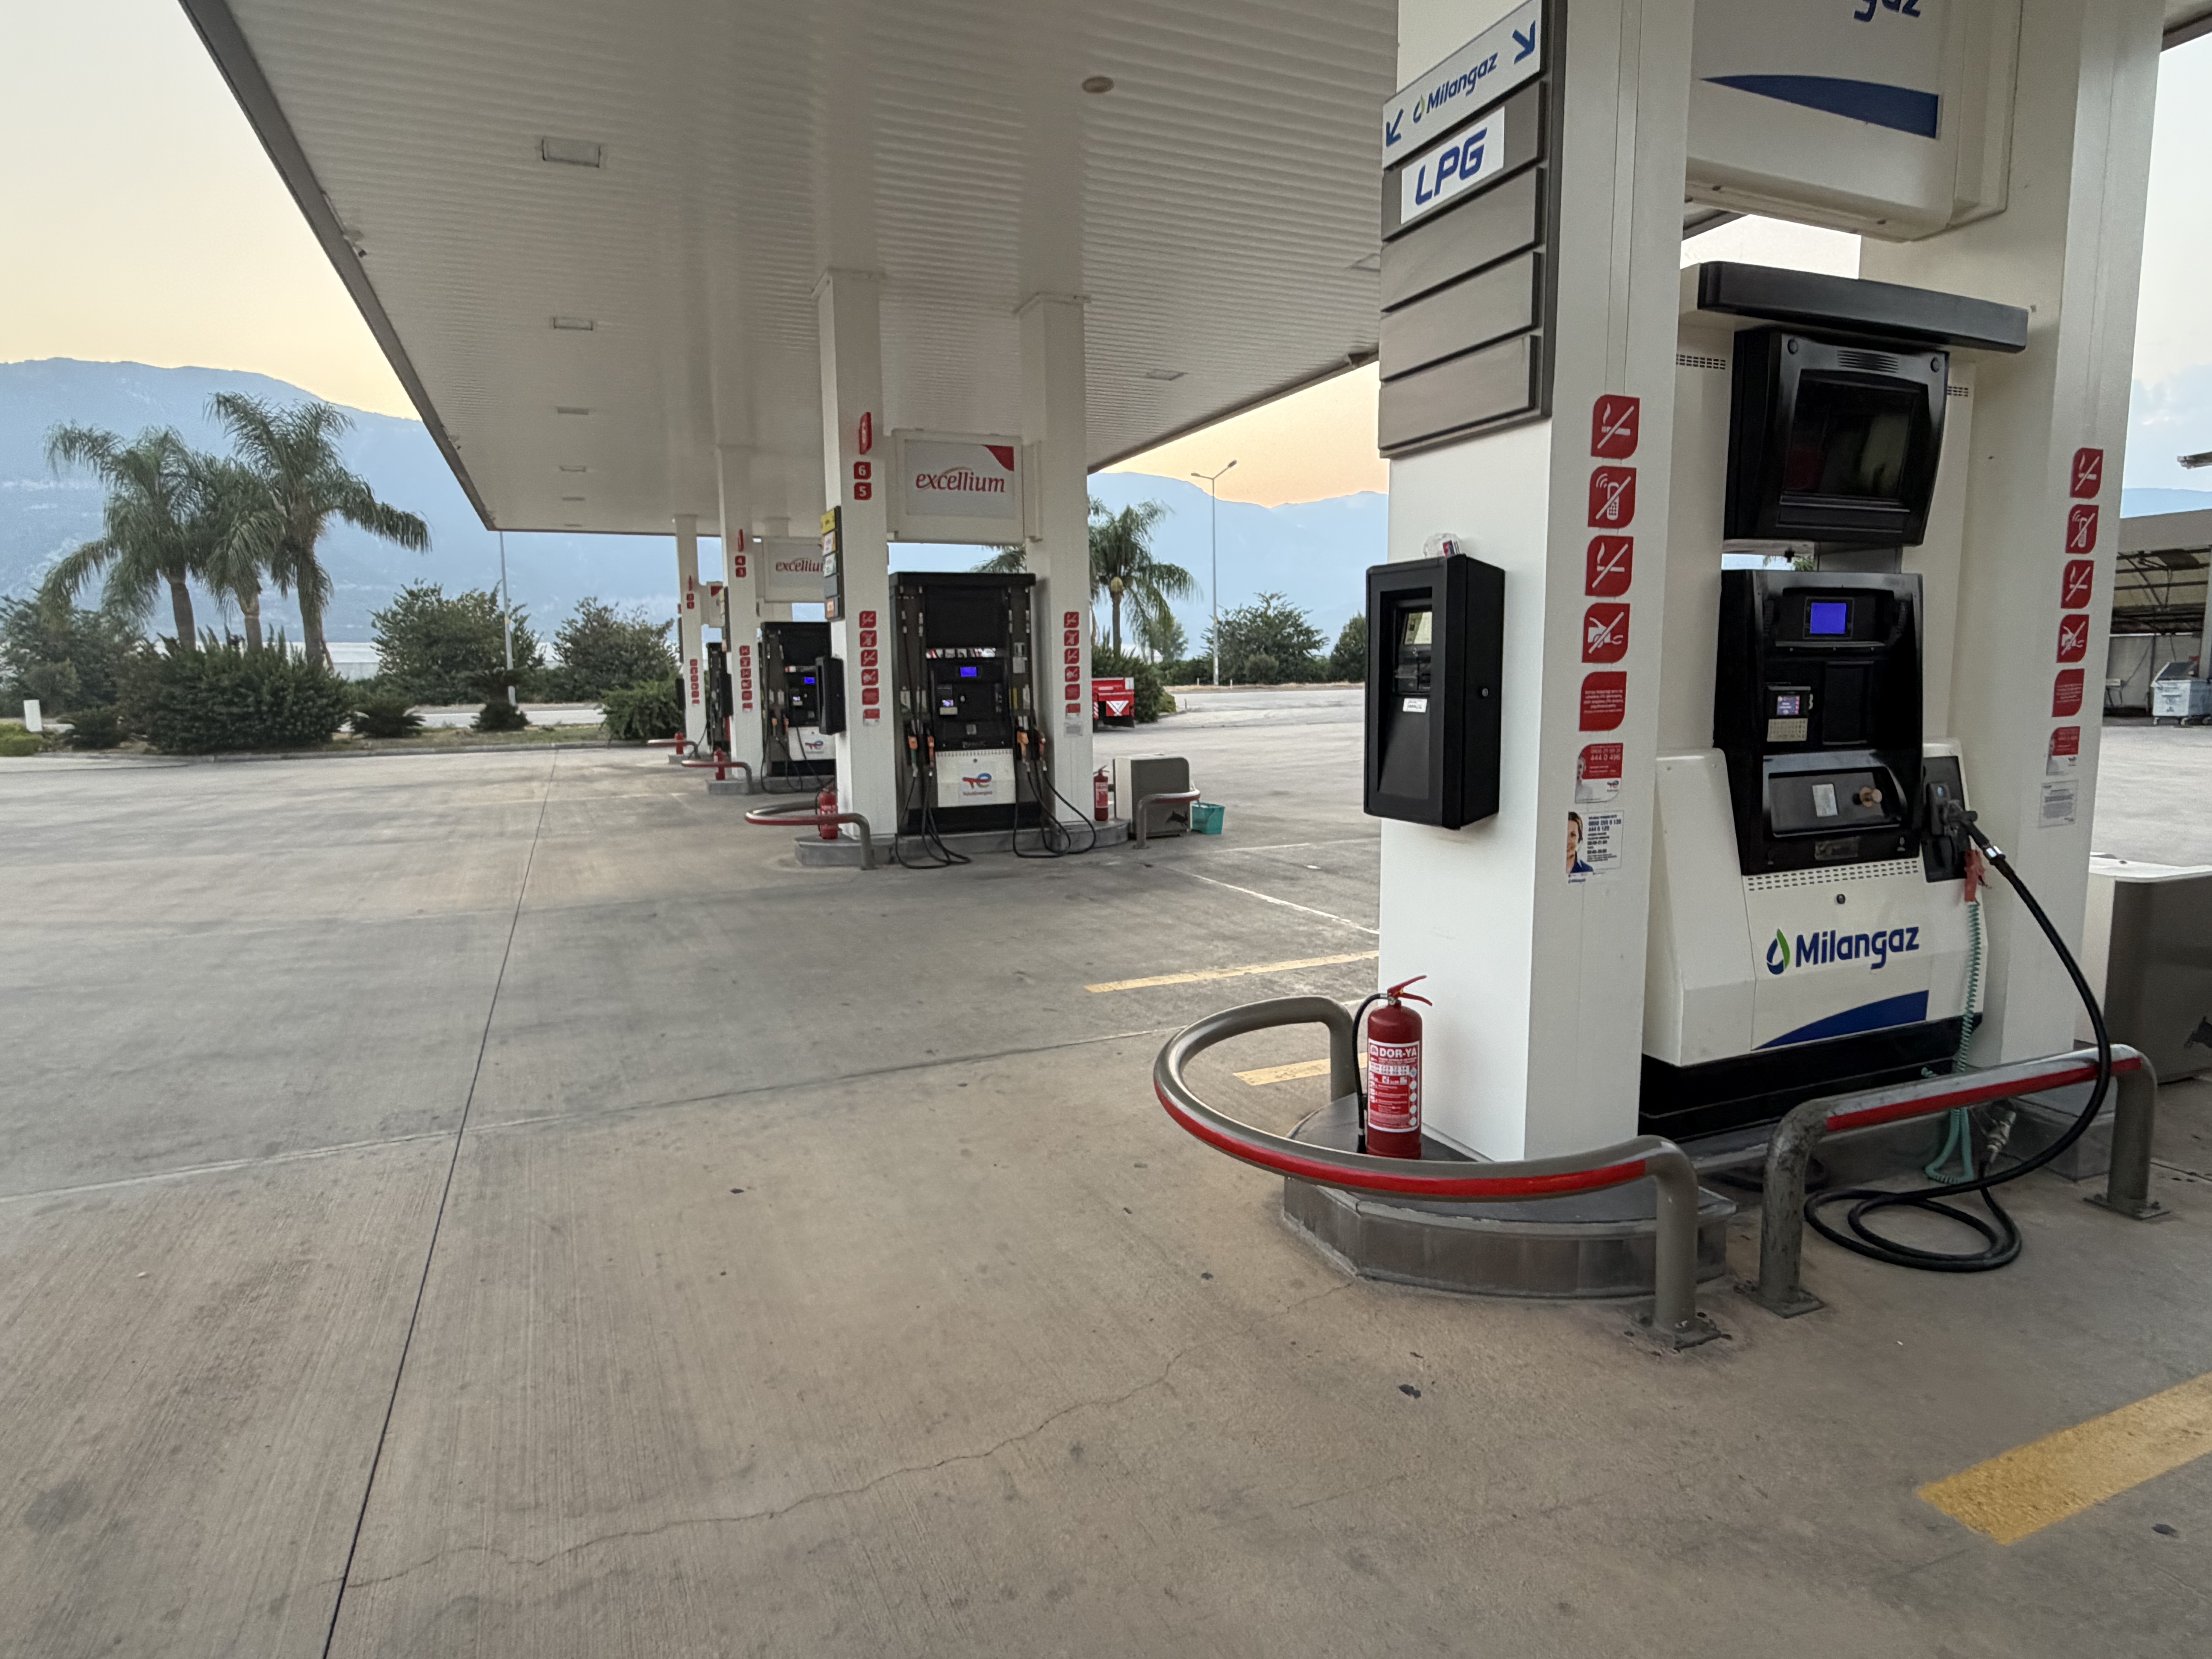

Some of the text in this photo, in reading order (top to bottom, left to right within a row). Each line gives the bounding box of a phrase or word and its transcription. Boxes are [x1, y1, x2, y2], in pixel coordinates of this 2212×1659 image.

[1426, 53, 1498, 113] Milangaz
[1415, 127, 1487, 206] LPG
[859, 465, 866, 476] 6
[859, 486, 867, 497] 5
[916, 471, 1005, 492] excellium
[1796, 926, 1919, 970] Milangaz
[1379, 1047, 1417, 1058] DOR-YA
